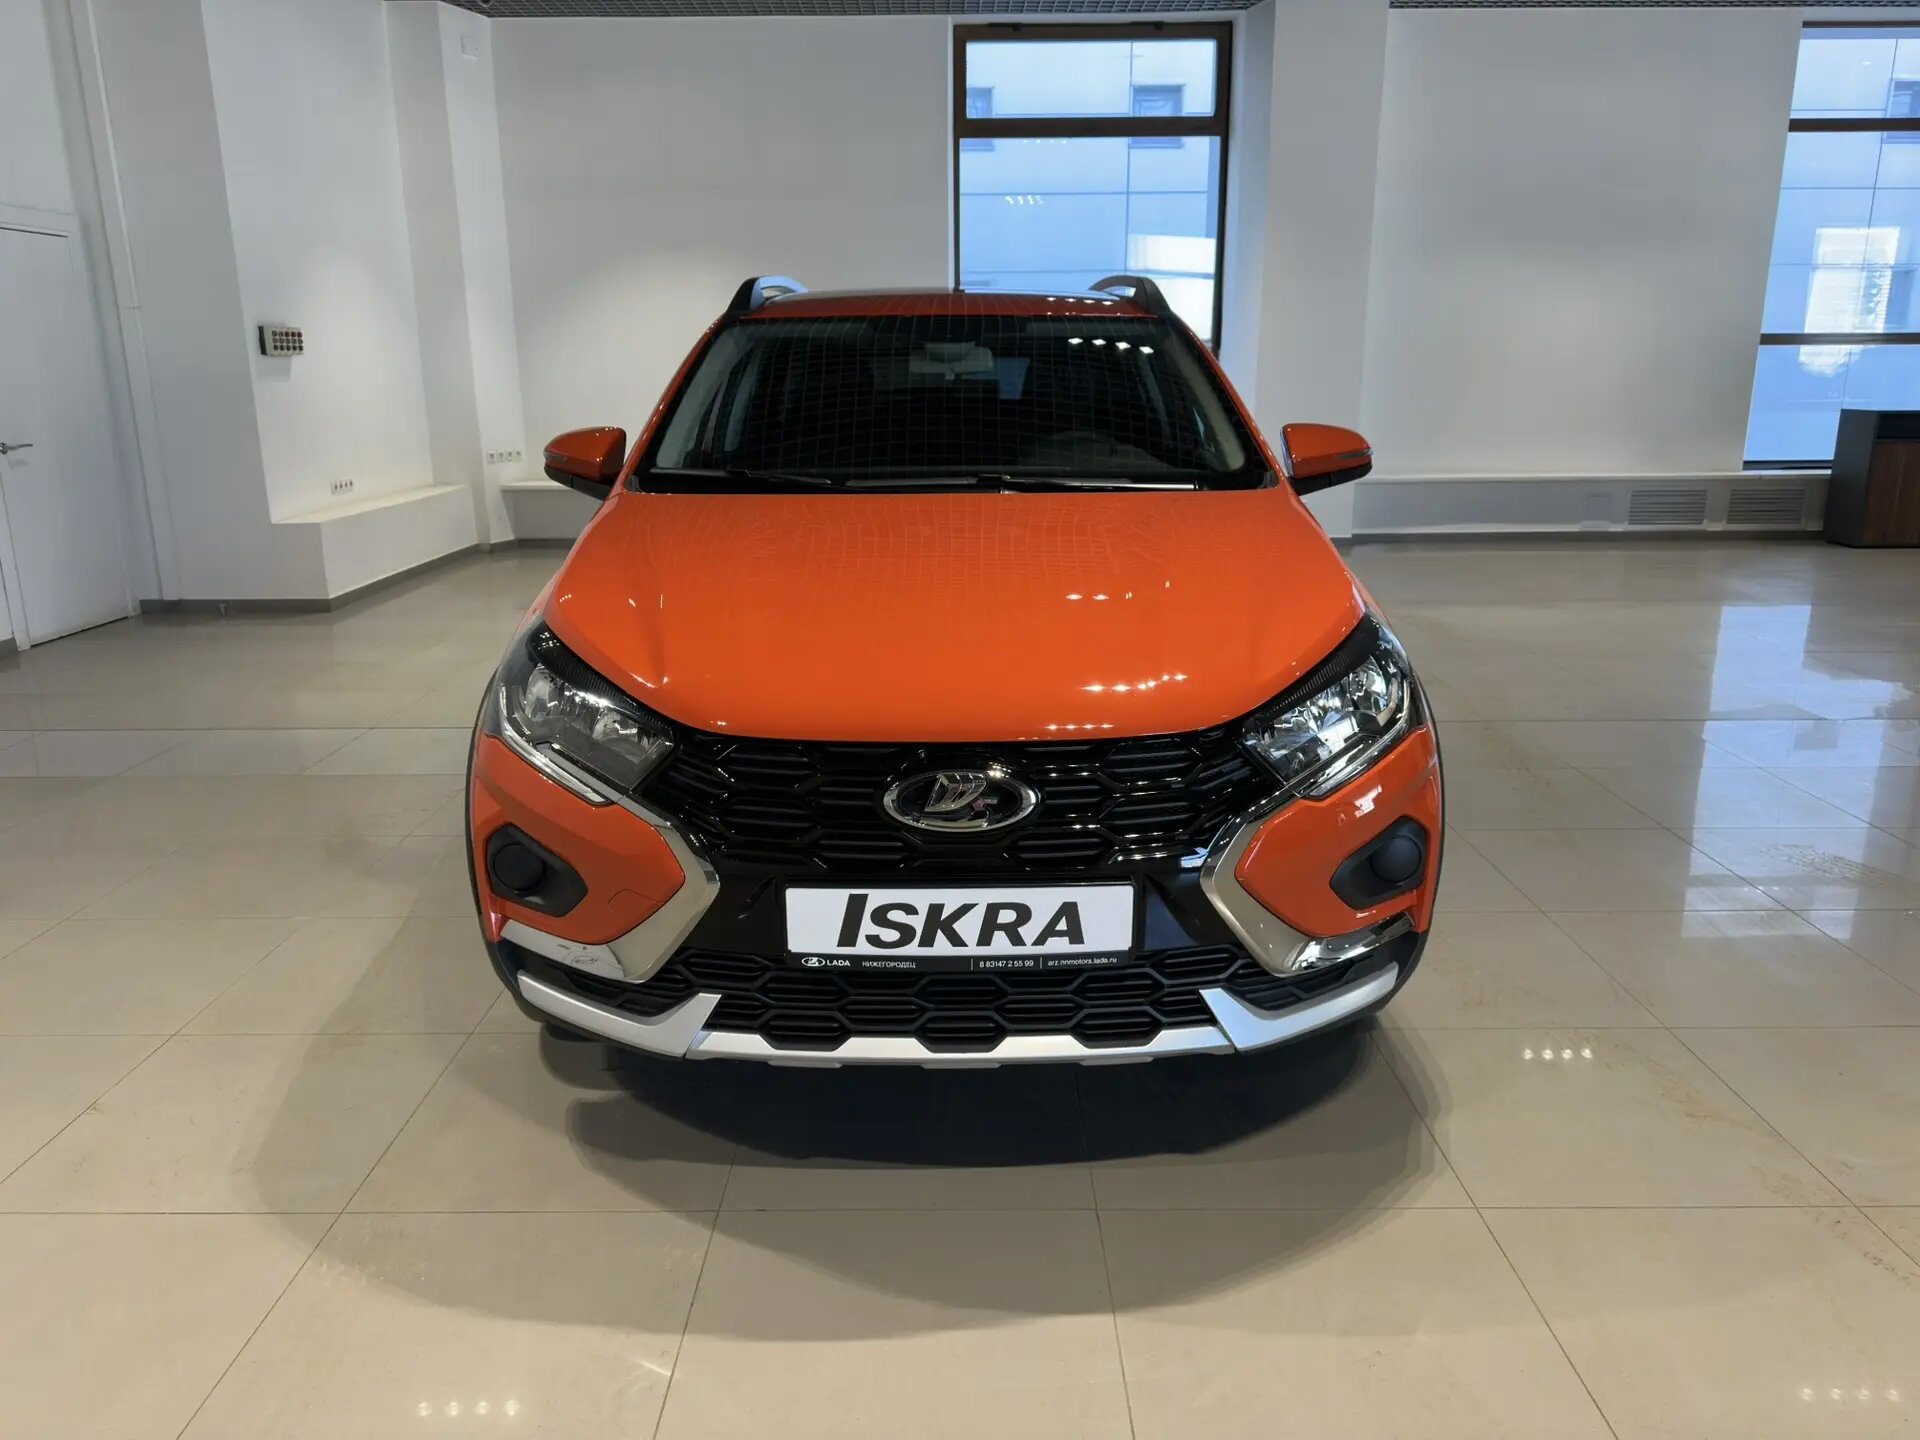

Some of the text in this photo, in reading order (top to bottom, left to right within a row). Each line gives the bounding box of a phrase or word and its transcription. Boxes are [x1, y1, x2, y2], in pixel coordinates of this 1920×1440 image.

[836, 893, 1086, 950] ISKRA
[826, 959, 851, 967] LADA
[985, 960, 1006, 968] 83147
